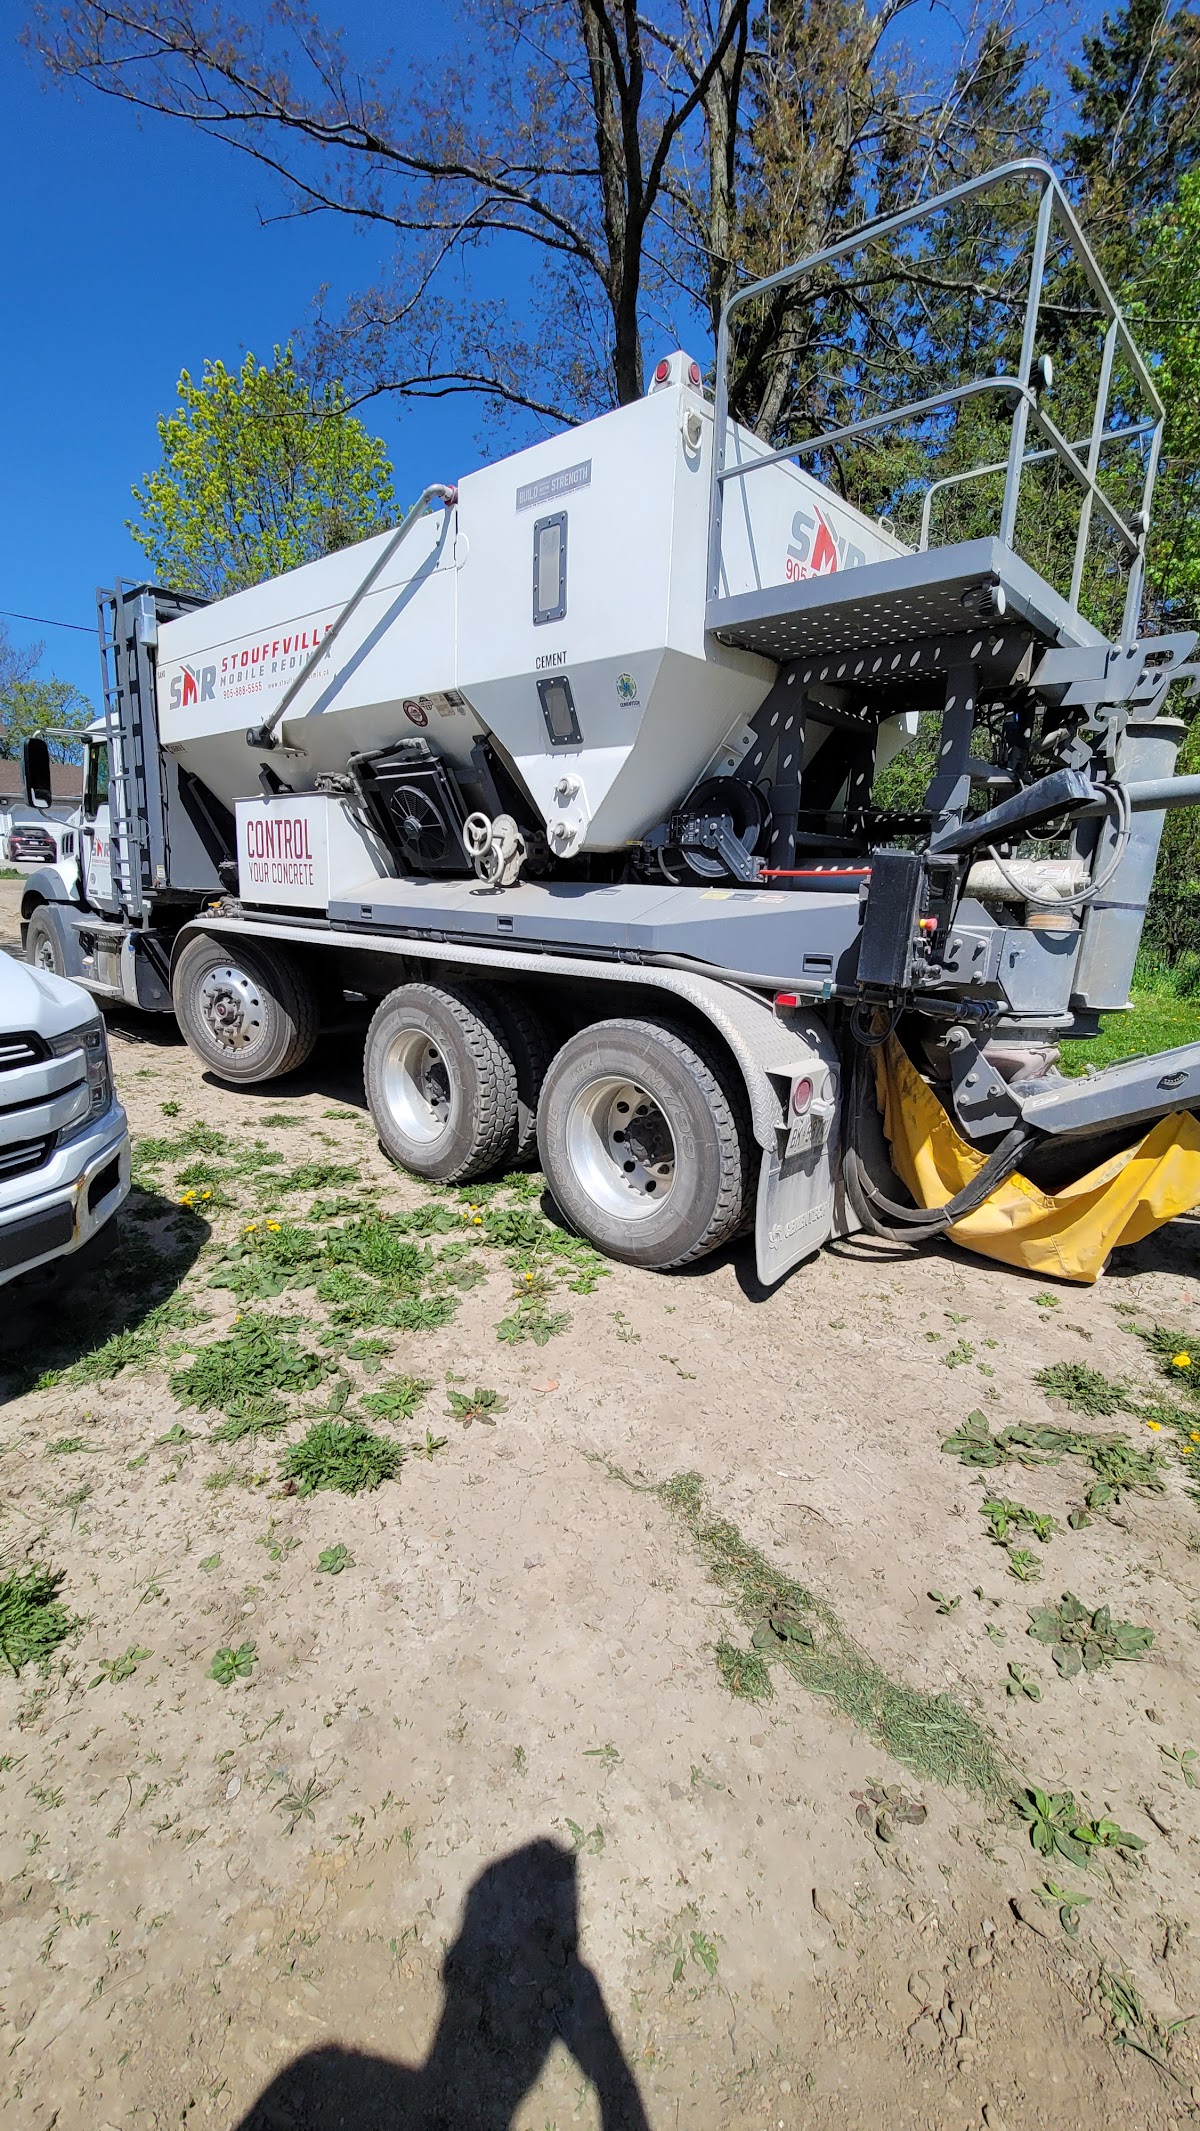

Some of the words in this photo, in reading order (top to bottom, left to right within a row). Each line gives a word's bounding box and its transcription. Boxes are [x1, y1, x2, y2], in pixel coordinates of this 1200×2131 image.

[519, 485, 538, 504] BUILD
[551, 466, 588, 492] STRENGTH
[219, 663, 265, 687] MOBILE
[535, 651, 568, 670] CEMENT
[169, 663, 217, 710] SMR
[247, 818, 313, 860] CONTROL
[248, 861, 270, 883] YOUR
[271, 862, 314, 886] CONCRETE
[640, 1065, 697, 1161] M799
